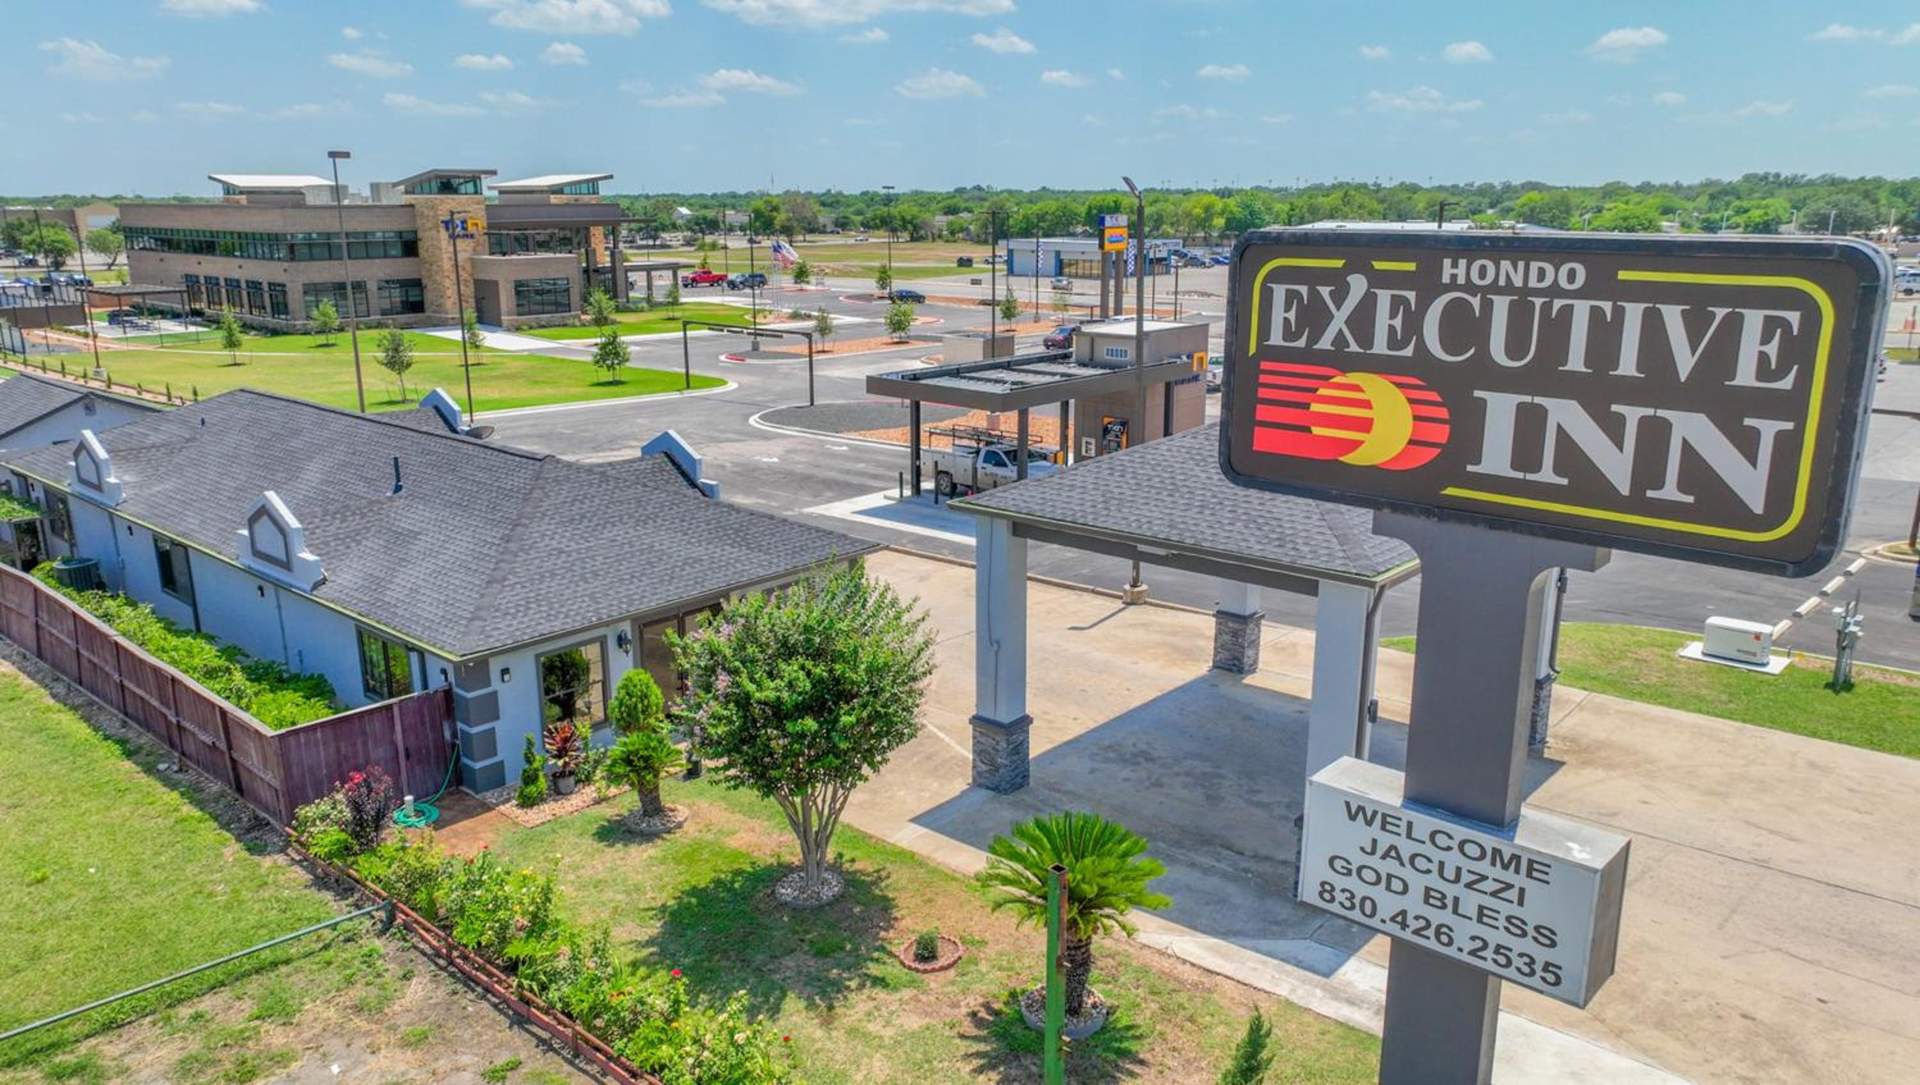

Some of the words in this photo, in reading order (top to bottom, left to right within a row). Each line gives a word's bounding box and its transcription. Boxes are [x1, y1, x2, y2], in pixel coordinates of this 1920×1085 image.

[1441, 257, 1586, 290] HONDO
[1264, 273, 1802, 390] EXECUTIVE
[1466, 390, 1795, 515] INN
[1344, 800, 1552, 884] WELCOME
[1360, 838, 1526, 907] JACUZZI
[1318, 880, 1562, 988] 830.426.2535
[1328, 854, 1409, 896] GOD
[1423, 885, 1558, 949] BLESS
